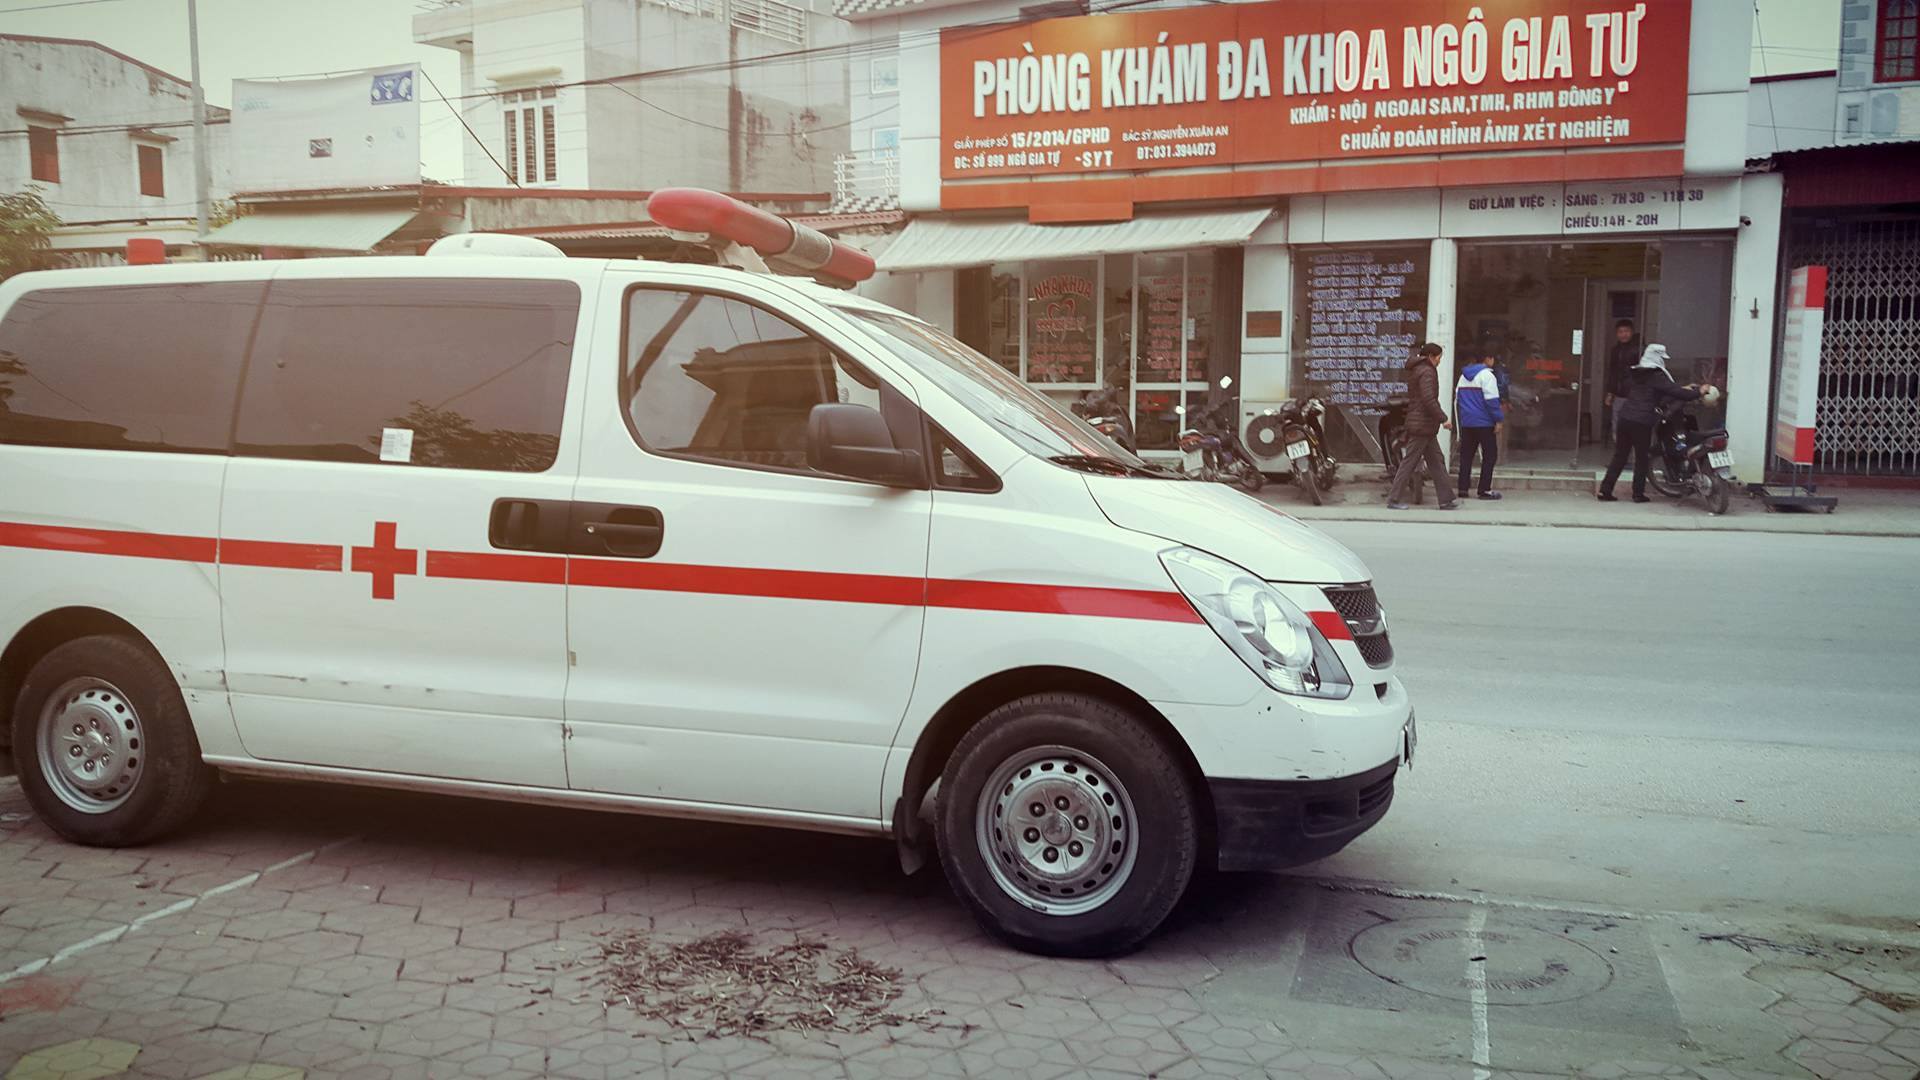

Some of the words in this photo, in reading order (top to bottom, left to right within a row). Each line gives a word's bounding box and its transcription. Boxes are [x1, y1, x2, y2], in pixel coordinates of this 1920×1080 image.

[974, 41, 1091, 118] PHÒNG
[1101, 31, 1207, 109] KHÁM
[1217, 38, 1272, 101] ĐA
[1283, 29, 1391, 96] KHOA
[1403, 7, 1489, 88] NGÔ
[1501, 15, 1573, 83] GIA
[1586, 3, 1647, 93] TỰ
[1340, 97, 1367, 124] NỘI
[1513, 91, 1554, 110] RHM
[1558, 85, 1602, 107] ĐÔNG
[1603, 87, 1615, 105] Y
[1215, 125, 1229, 137] AN
[1340, 124, 1390, 151] CHUẨN
[1394, 124, 1438, 148] ĐOÁN
[1483, 119, 1520, 143] ẢNH
[1523, 116, 1556, 141] XÉT
[1007, 150, 1027, 167] NGÔ
[1029, 152, 1045, 165] GIA
[1047, 150, 1061, 168] TỰ
[1636, 212, 1659, 226] 20H
